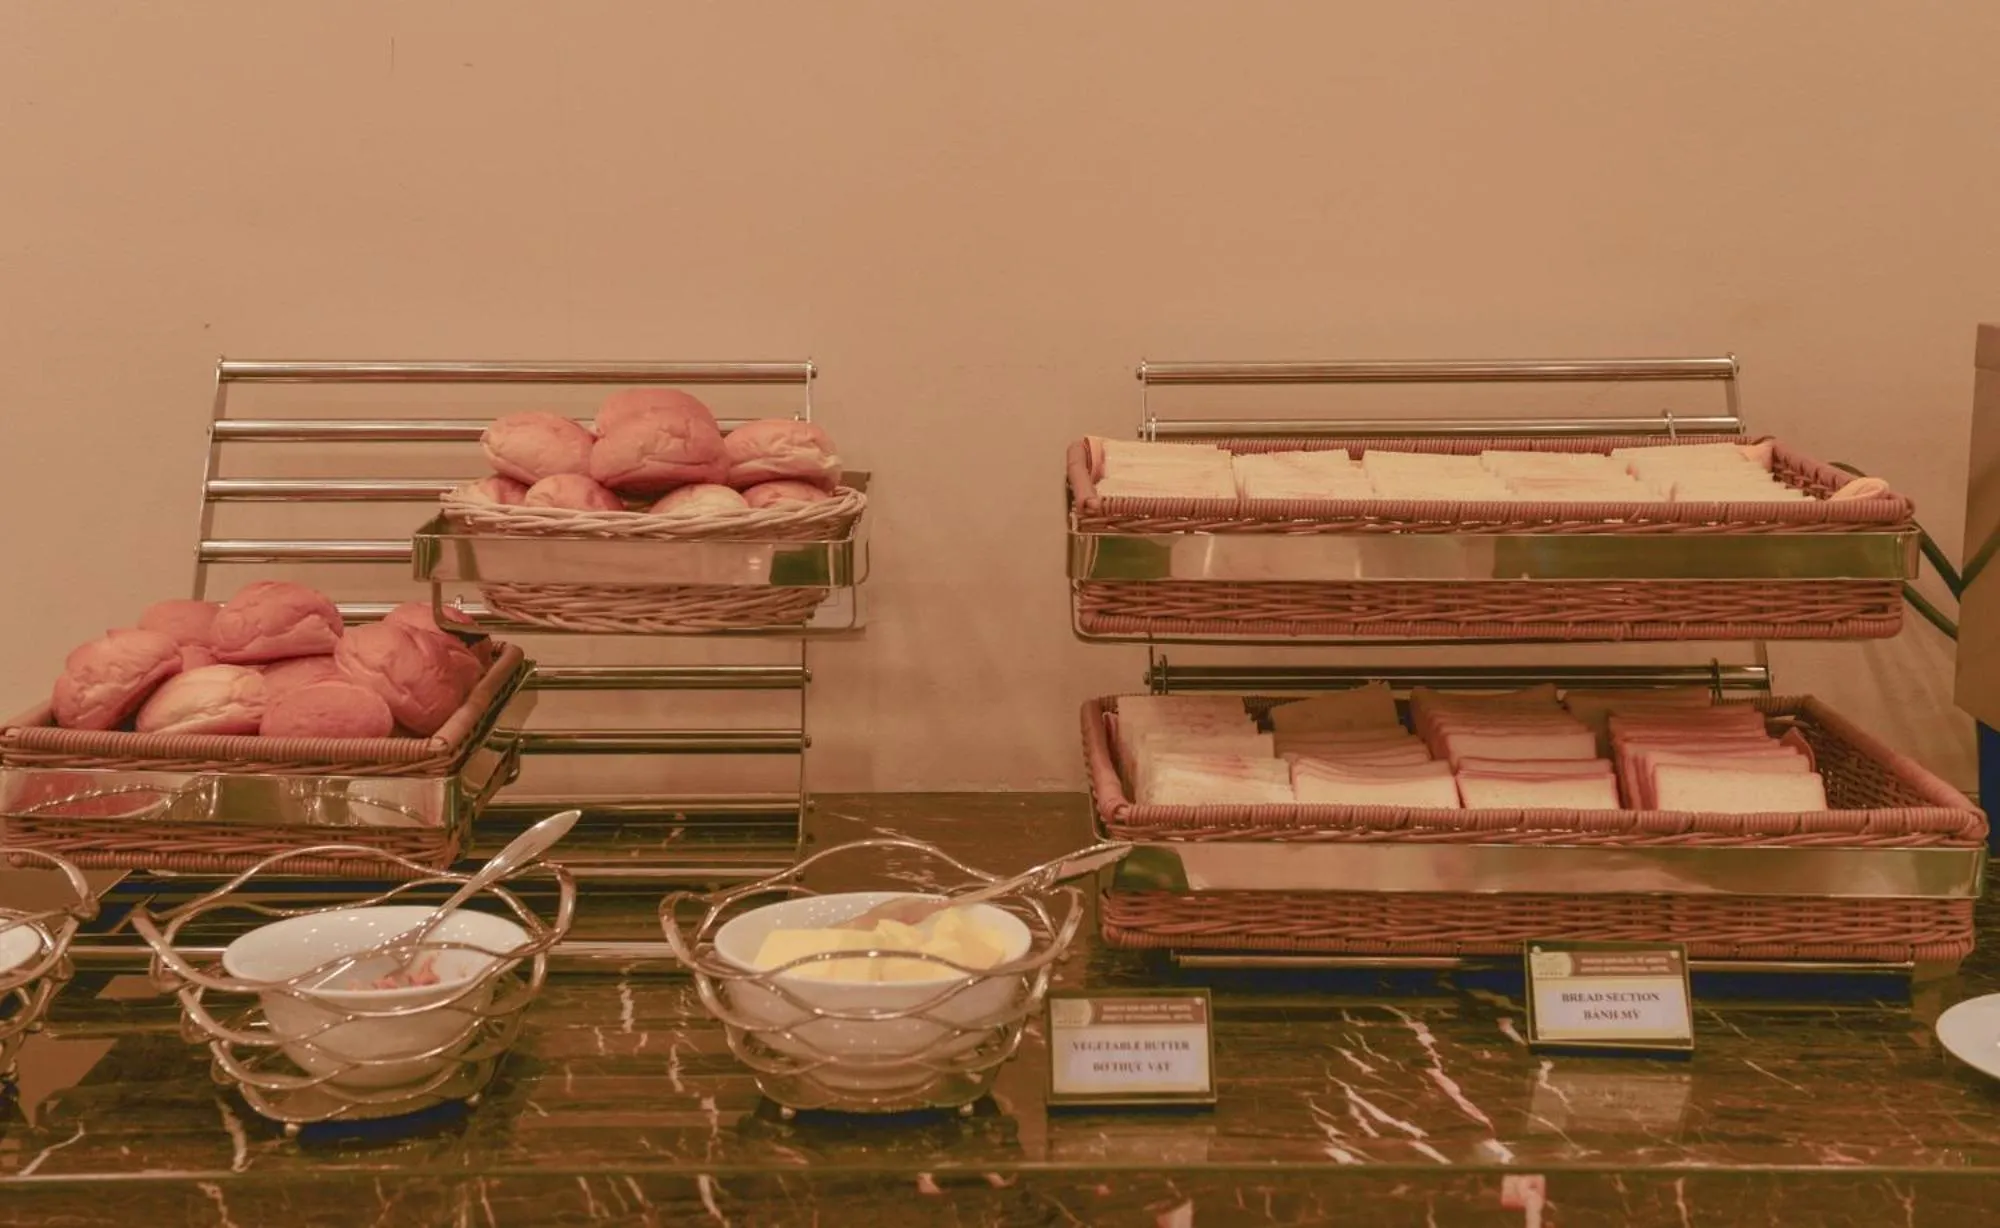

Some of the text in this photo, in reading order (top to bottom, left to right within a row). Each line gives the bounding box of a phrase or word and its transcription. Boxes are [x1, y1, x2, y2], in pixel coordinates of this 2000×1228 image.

[1562, 992, 1660, 1002] BREAD SECTION
[1584, 1007, 1618, 1020] BÁNH
[1072, 1041, 1190, 1051] VEGETABLE BUTTER
